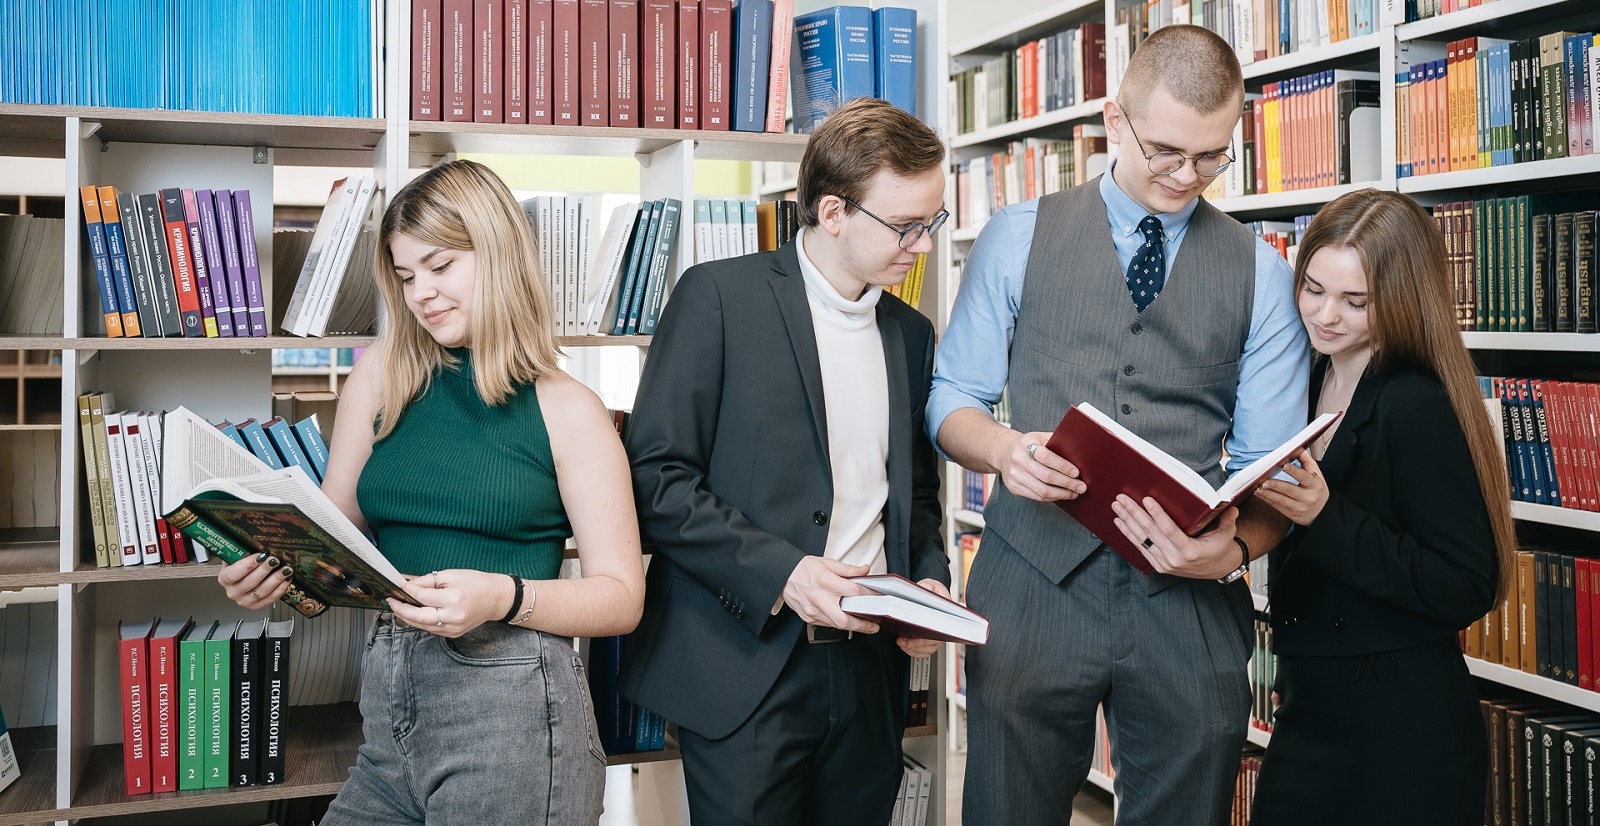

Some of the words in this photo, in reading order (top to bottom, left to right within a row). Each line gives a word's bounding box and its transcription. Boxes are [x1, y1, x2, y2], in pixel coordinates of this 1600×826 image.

[1543, 69, 1551, 96] lawyers
[1554, 67, 1562, 93] lawyers
[1555, 107, 1564, 134] English
[126, 216, 136, 240] Уголовное
[138, 275, 146, 291] Общая
[149, 215, 157, 239] Уголовное
[160, 274, 168, 300] Особенная
[173, 228, 190, 292] КРИМИНОЛОГИЯ
[191, 227, 205, 278] КРИМИНОЛОГИЯ
[1535, 263, 1543, 318] English
[1559, 261, 1568, 318] English
[1580, 260, 1590, 318] English
[1513, 406, 1521, 440] ЛОГИКА
[1525, 406, 1533, 441] ЛОГИКА
[1539, 407, 1548, 442] ЛОГИКА
[132, 684, 142, 759] ПСИХОЛОГИЯ
[160, 683, 168, 758] ПСИХОЛОГИЯ
[188, 688, 196, 756] ПСИХОЛОГИЯ
[212, 688, 220, 755] ПСИХОЛОГИЯ
[241, 681, 250, 760] ПСИХОЛОГИЯ
[269, 679, 280, 758] ПСИХОЛОГИЯ
[136, 778, 141, 786] 1
[162, 776, 166, 785] 1
[188, 769, 194, 778] 2
[212, 768, 218, 777] 2
[240, 774, 247, 785] 3
[267, 772, 274, 782] 3
